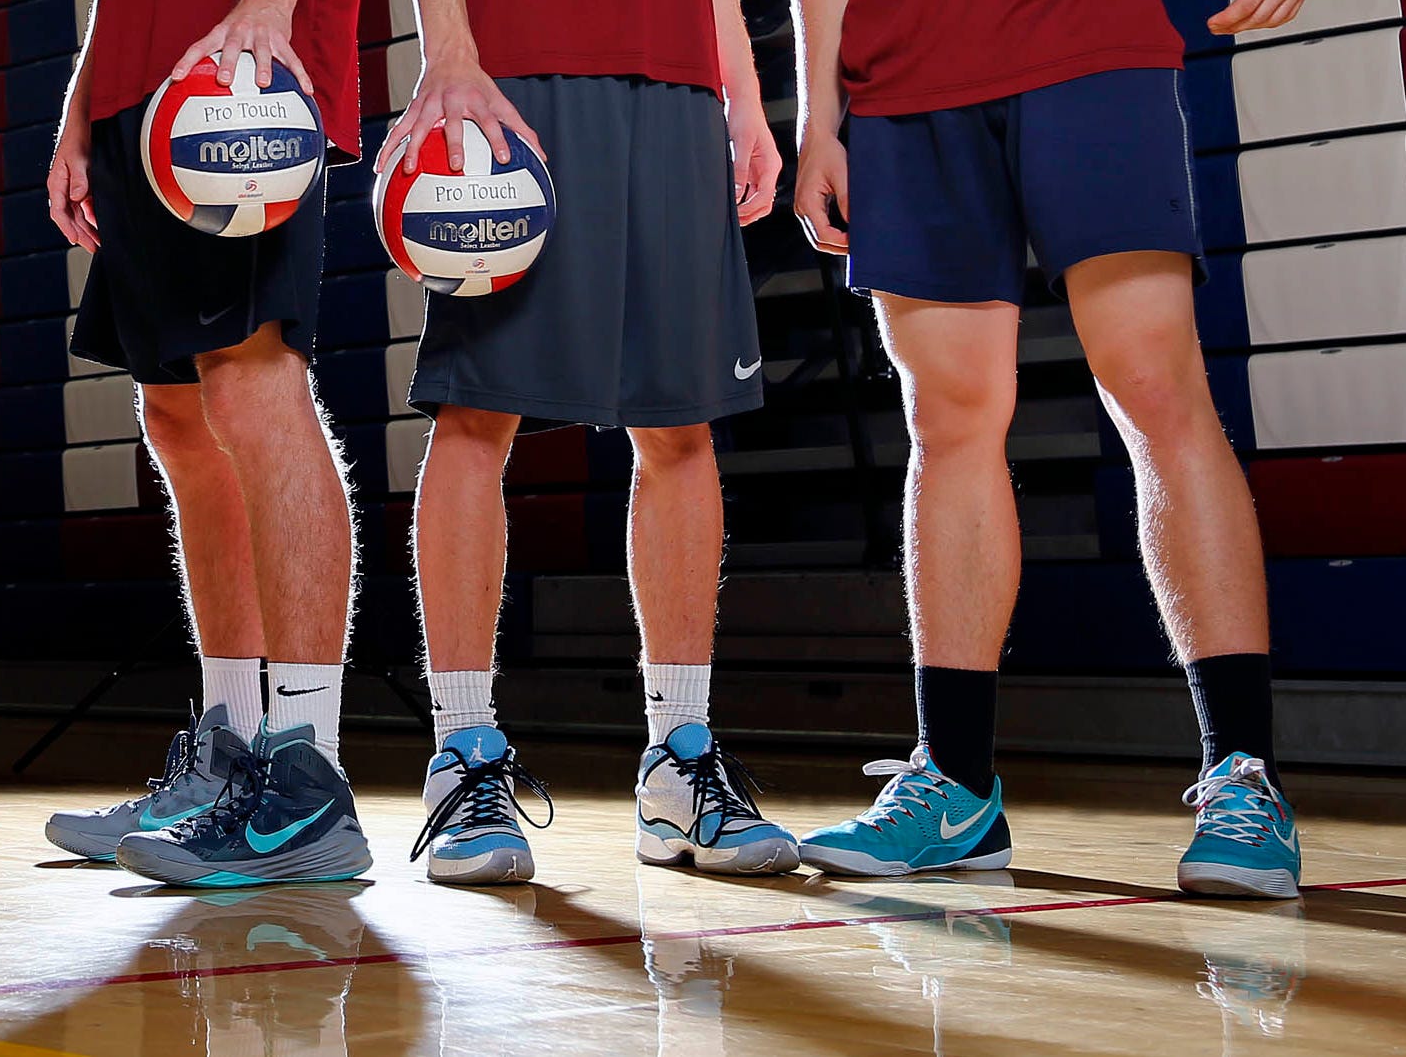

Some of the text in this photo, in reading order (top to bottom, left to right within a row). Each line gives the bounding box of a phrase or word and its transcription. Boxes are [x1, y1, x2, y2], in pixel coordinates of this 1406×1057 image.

[204, 101, 287, 122] Pro Touch
[199, 135, 301, 163] molten
[435, 182, 517, 202] Pro Touch
[429, 217, 529, 243] molten
